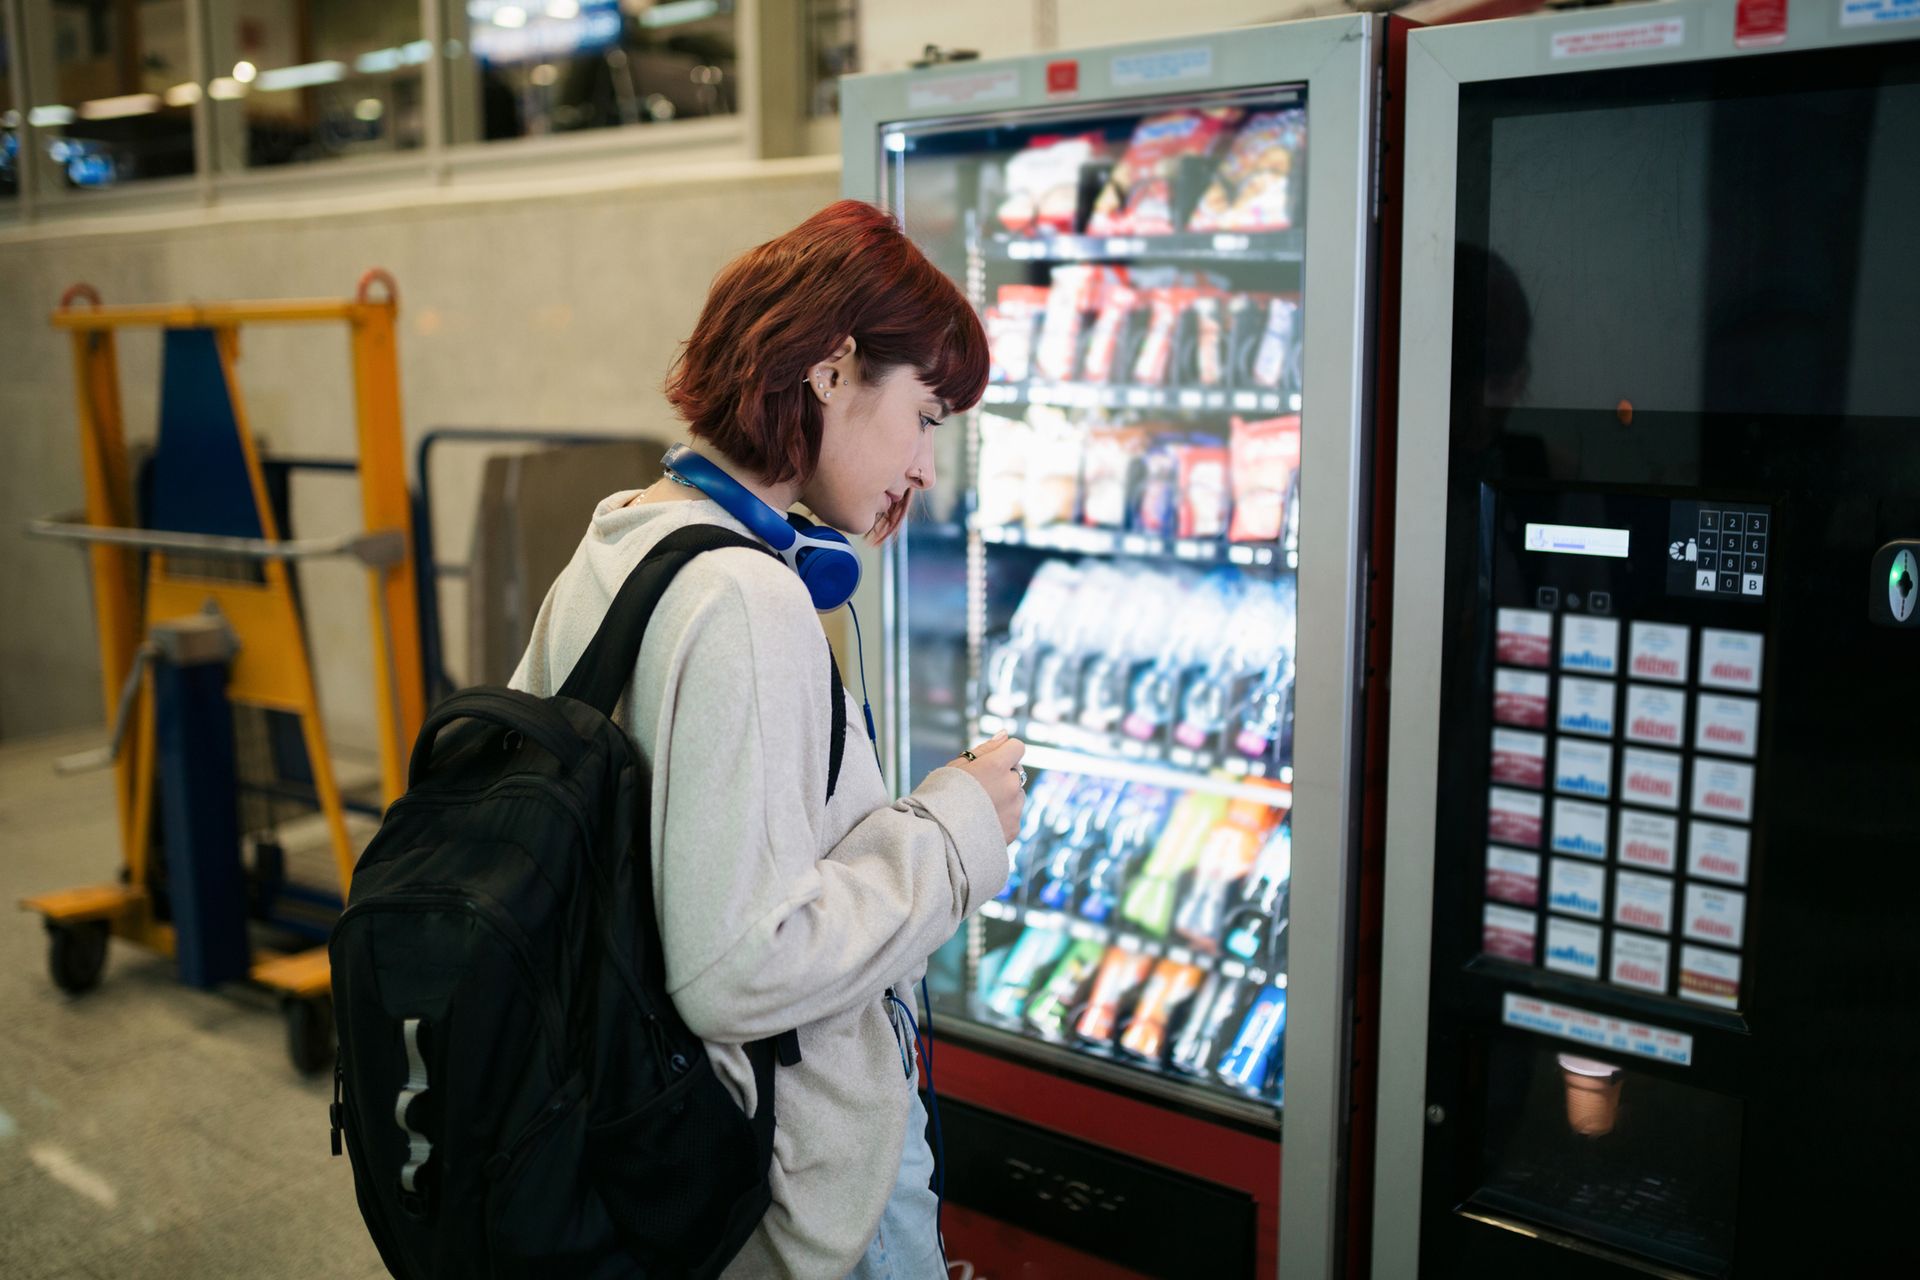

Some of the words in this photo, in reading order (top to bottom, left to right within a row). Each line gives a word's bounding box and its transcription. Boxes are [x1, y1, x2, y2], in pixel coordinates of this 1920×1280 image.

[1707, 517, 1712, 526] 1
[1729, 518, 1736, 528] 2
[1753, 520, 1760, 529] 3
[1705, 537, 1711, 545] 4
[1728, 538, 1735, 548] 5
[1752, 540, 1759, 550] 6
[1704, 557, 1710, 566] 7
[1727, 558, 1734, 568] 8
[1751, 560, 1758, 570] 9
[1701, 576, 1710, 586] A
[1726, 578, 1733, 588] 0
[1748, 580, 1757, 590] B
[1006, 1158, 1126, 1213] PUSH
